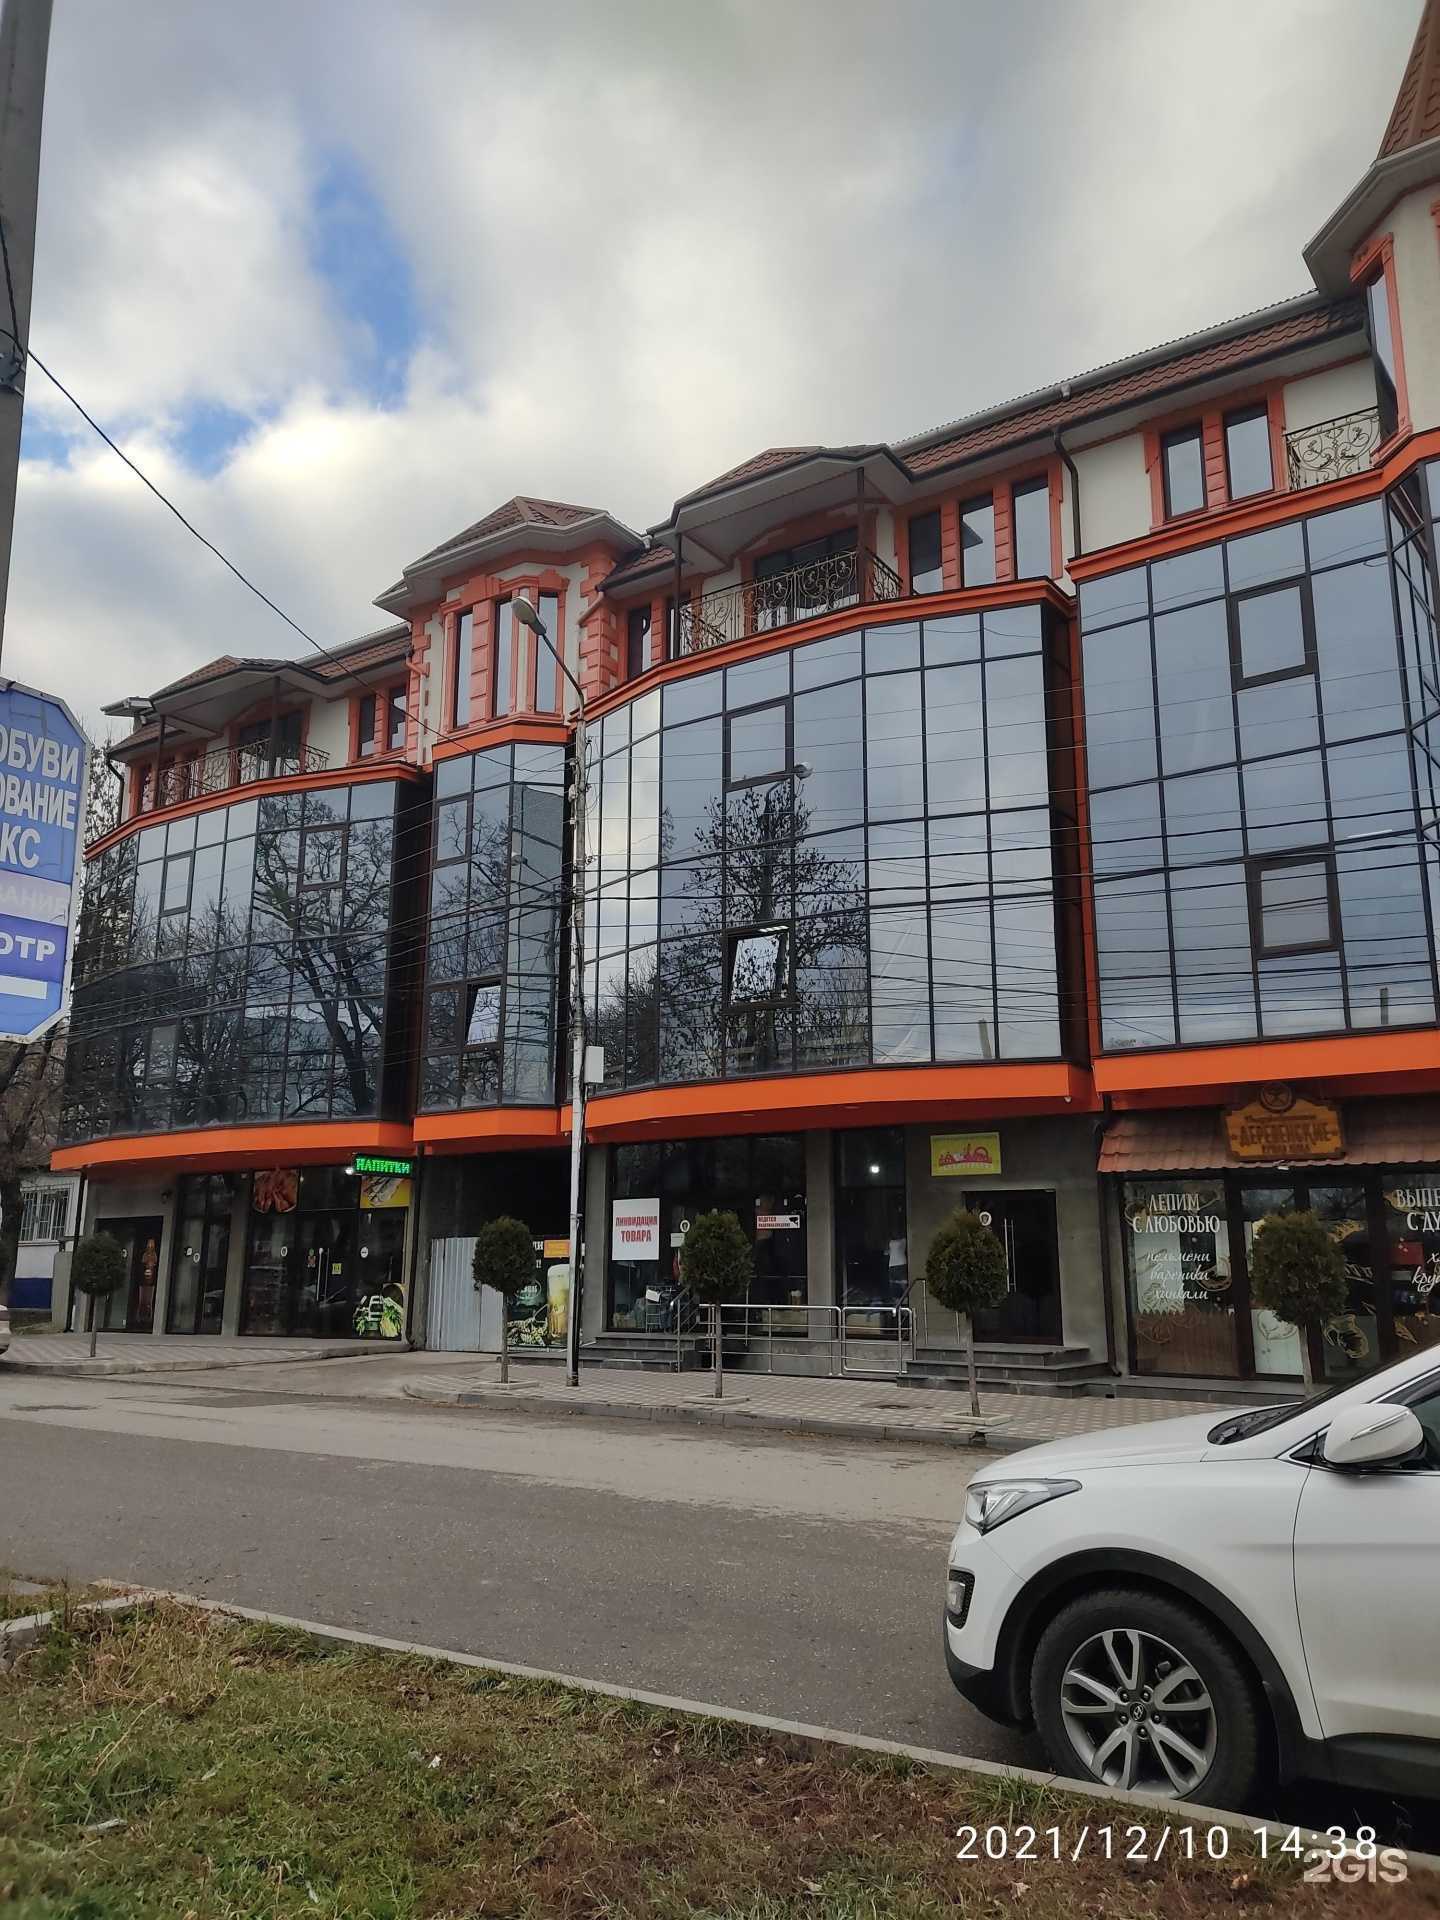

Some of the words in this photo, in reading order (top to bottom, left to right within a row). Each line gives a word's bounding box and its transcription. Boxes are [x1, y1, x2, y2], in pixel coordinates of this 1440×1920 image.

[356, 1158, 411, 1174] НАПИТКИ
[1148, 1193, 1200, 1212] ЛЕПИМ
[1396, 1188, 1440, 1208] ВЫПЕ
[615, 1215, 658, 1228] ЛИКВИДАЦИЯ
[1133, 1216, 1143, 1233] С
[1145, 1215, 1220, 1233] ЛЮБОВЬЮ
[1406, 1212, 1419, 1231] С
[620, 1230, 652, 1242] ТОВАРА
